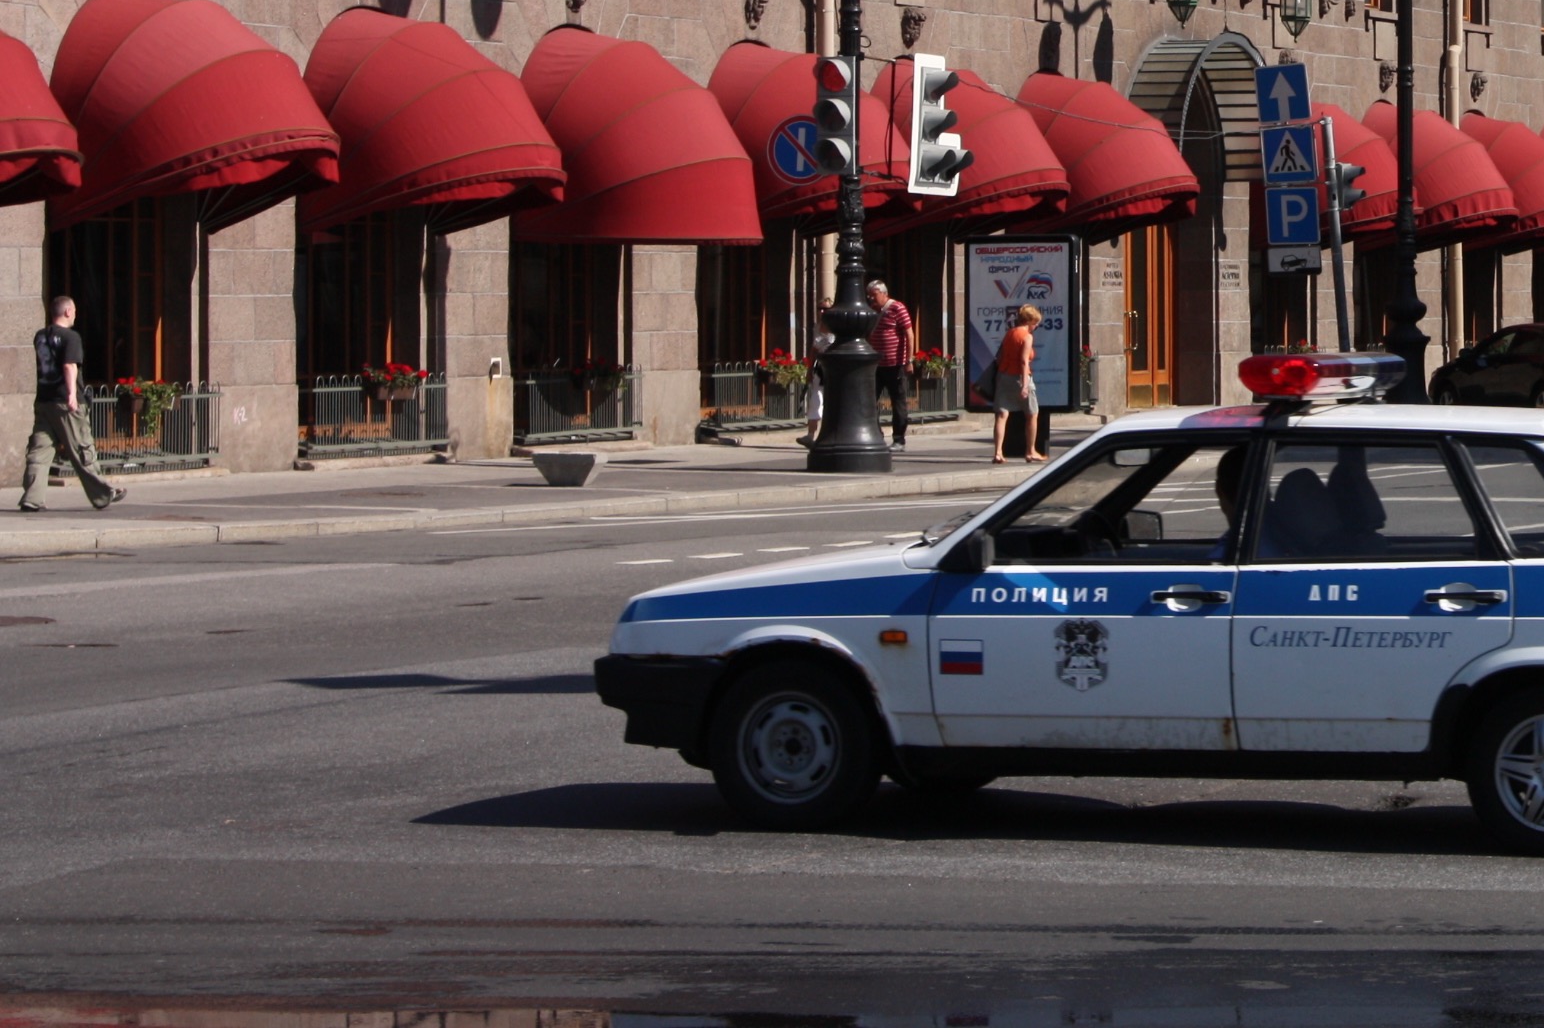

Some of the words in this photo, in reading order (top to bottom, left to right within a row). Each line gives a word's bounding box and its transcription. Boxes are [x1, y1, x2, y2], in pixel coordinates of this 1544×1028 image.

[975, 245, 1063, 255] ОБЩЕРОССИЙСКИЙ
[988, 265, 1020, 274] ФРОНТ
[971, 587, 1108, 606] ПОЛИЦИЯ
[1308, 585, 1359, 601] ДПС
